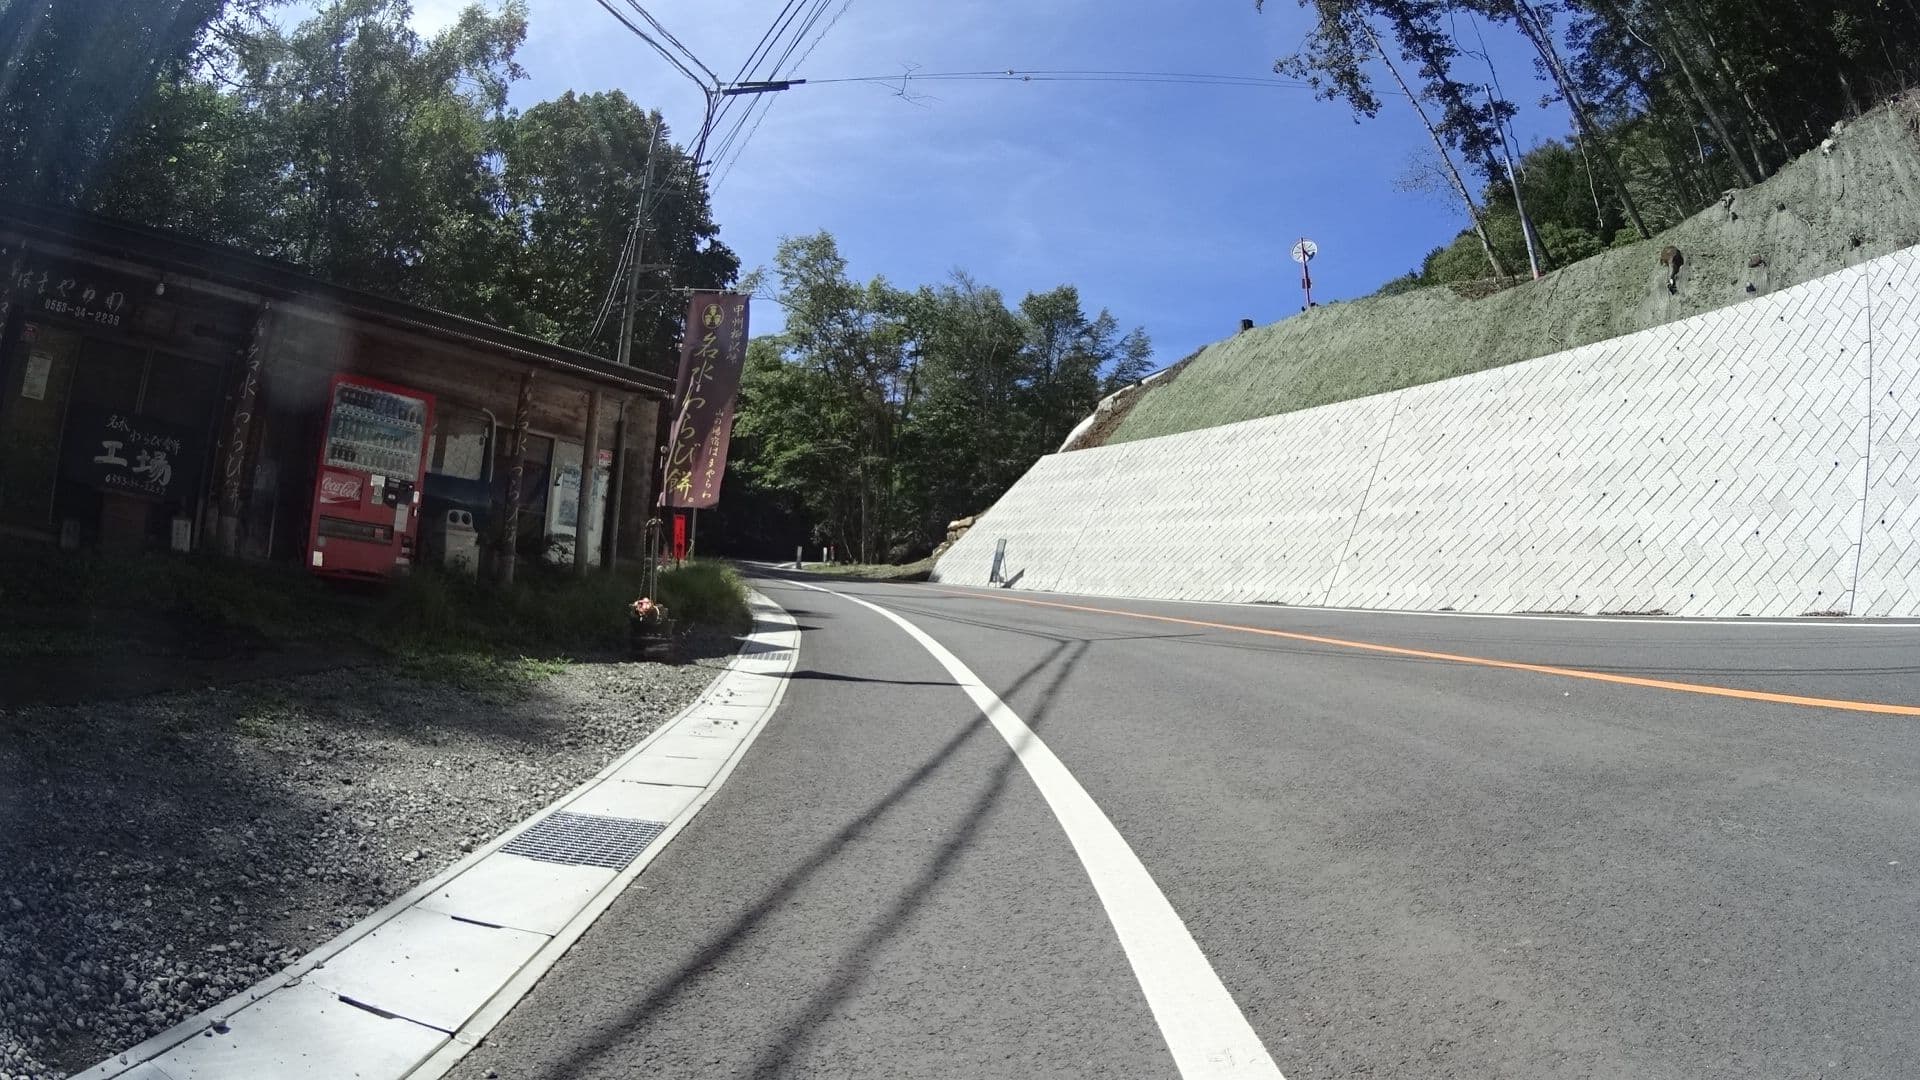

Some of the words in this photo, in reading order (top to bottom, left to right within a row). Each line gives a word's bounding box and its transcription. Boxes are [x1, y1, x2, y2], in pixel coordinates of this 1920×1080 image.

[93, 440, 172, 486] 工場
[666, 331, 719, 501] 名水わらび餅
